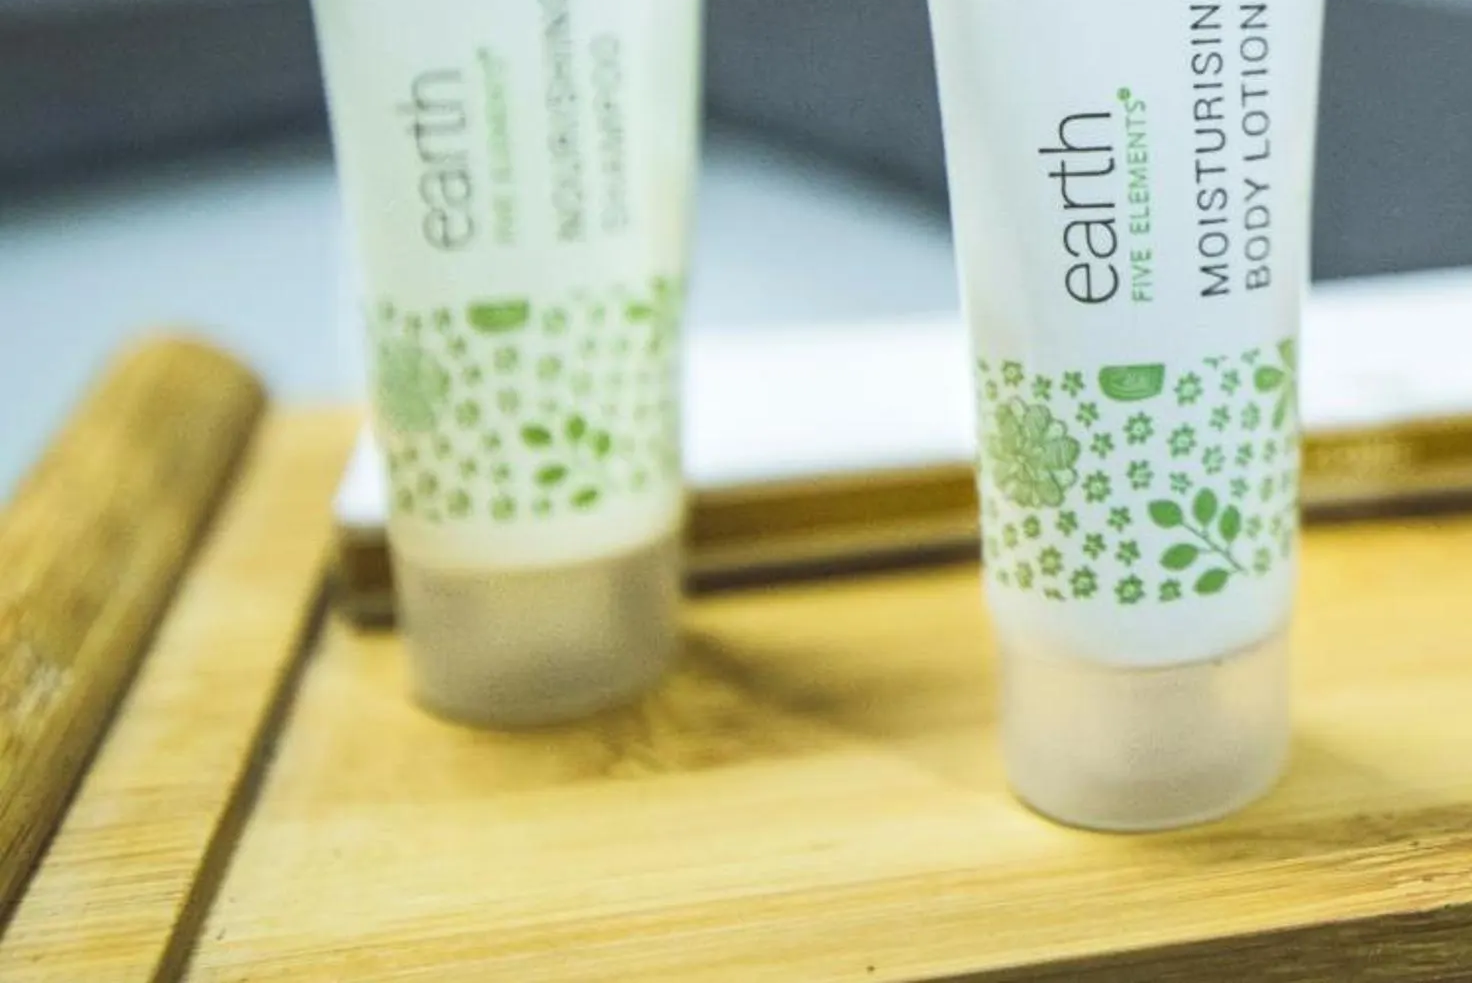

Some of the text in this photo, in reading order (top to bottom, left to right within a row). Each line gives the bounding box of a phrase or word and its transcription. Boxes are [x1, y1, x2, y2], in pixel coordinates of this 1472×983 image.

[395, 66, 475, 251] earth
[1038, 111, 1119, 305] earth
[1240, 3, 1271, 292] BODY LOTION
[1129, 248, 1153, 304] FIVE
